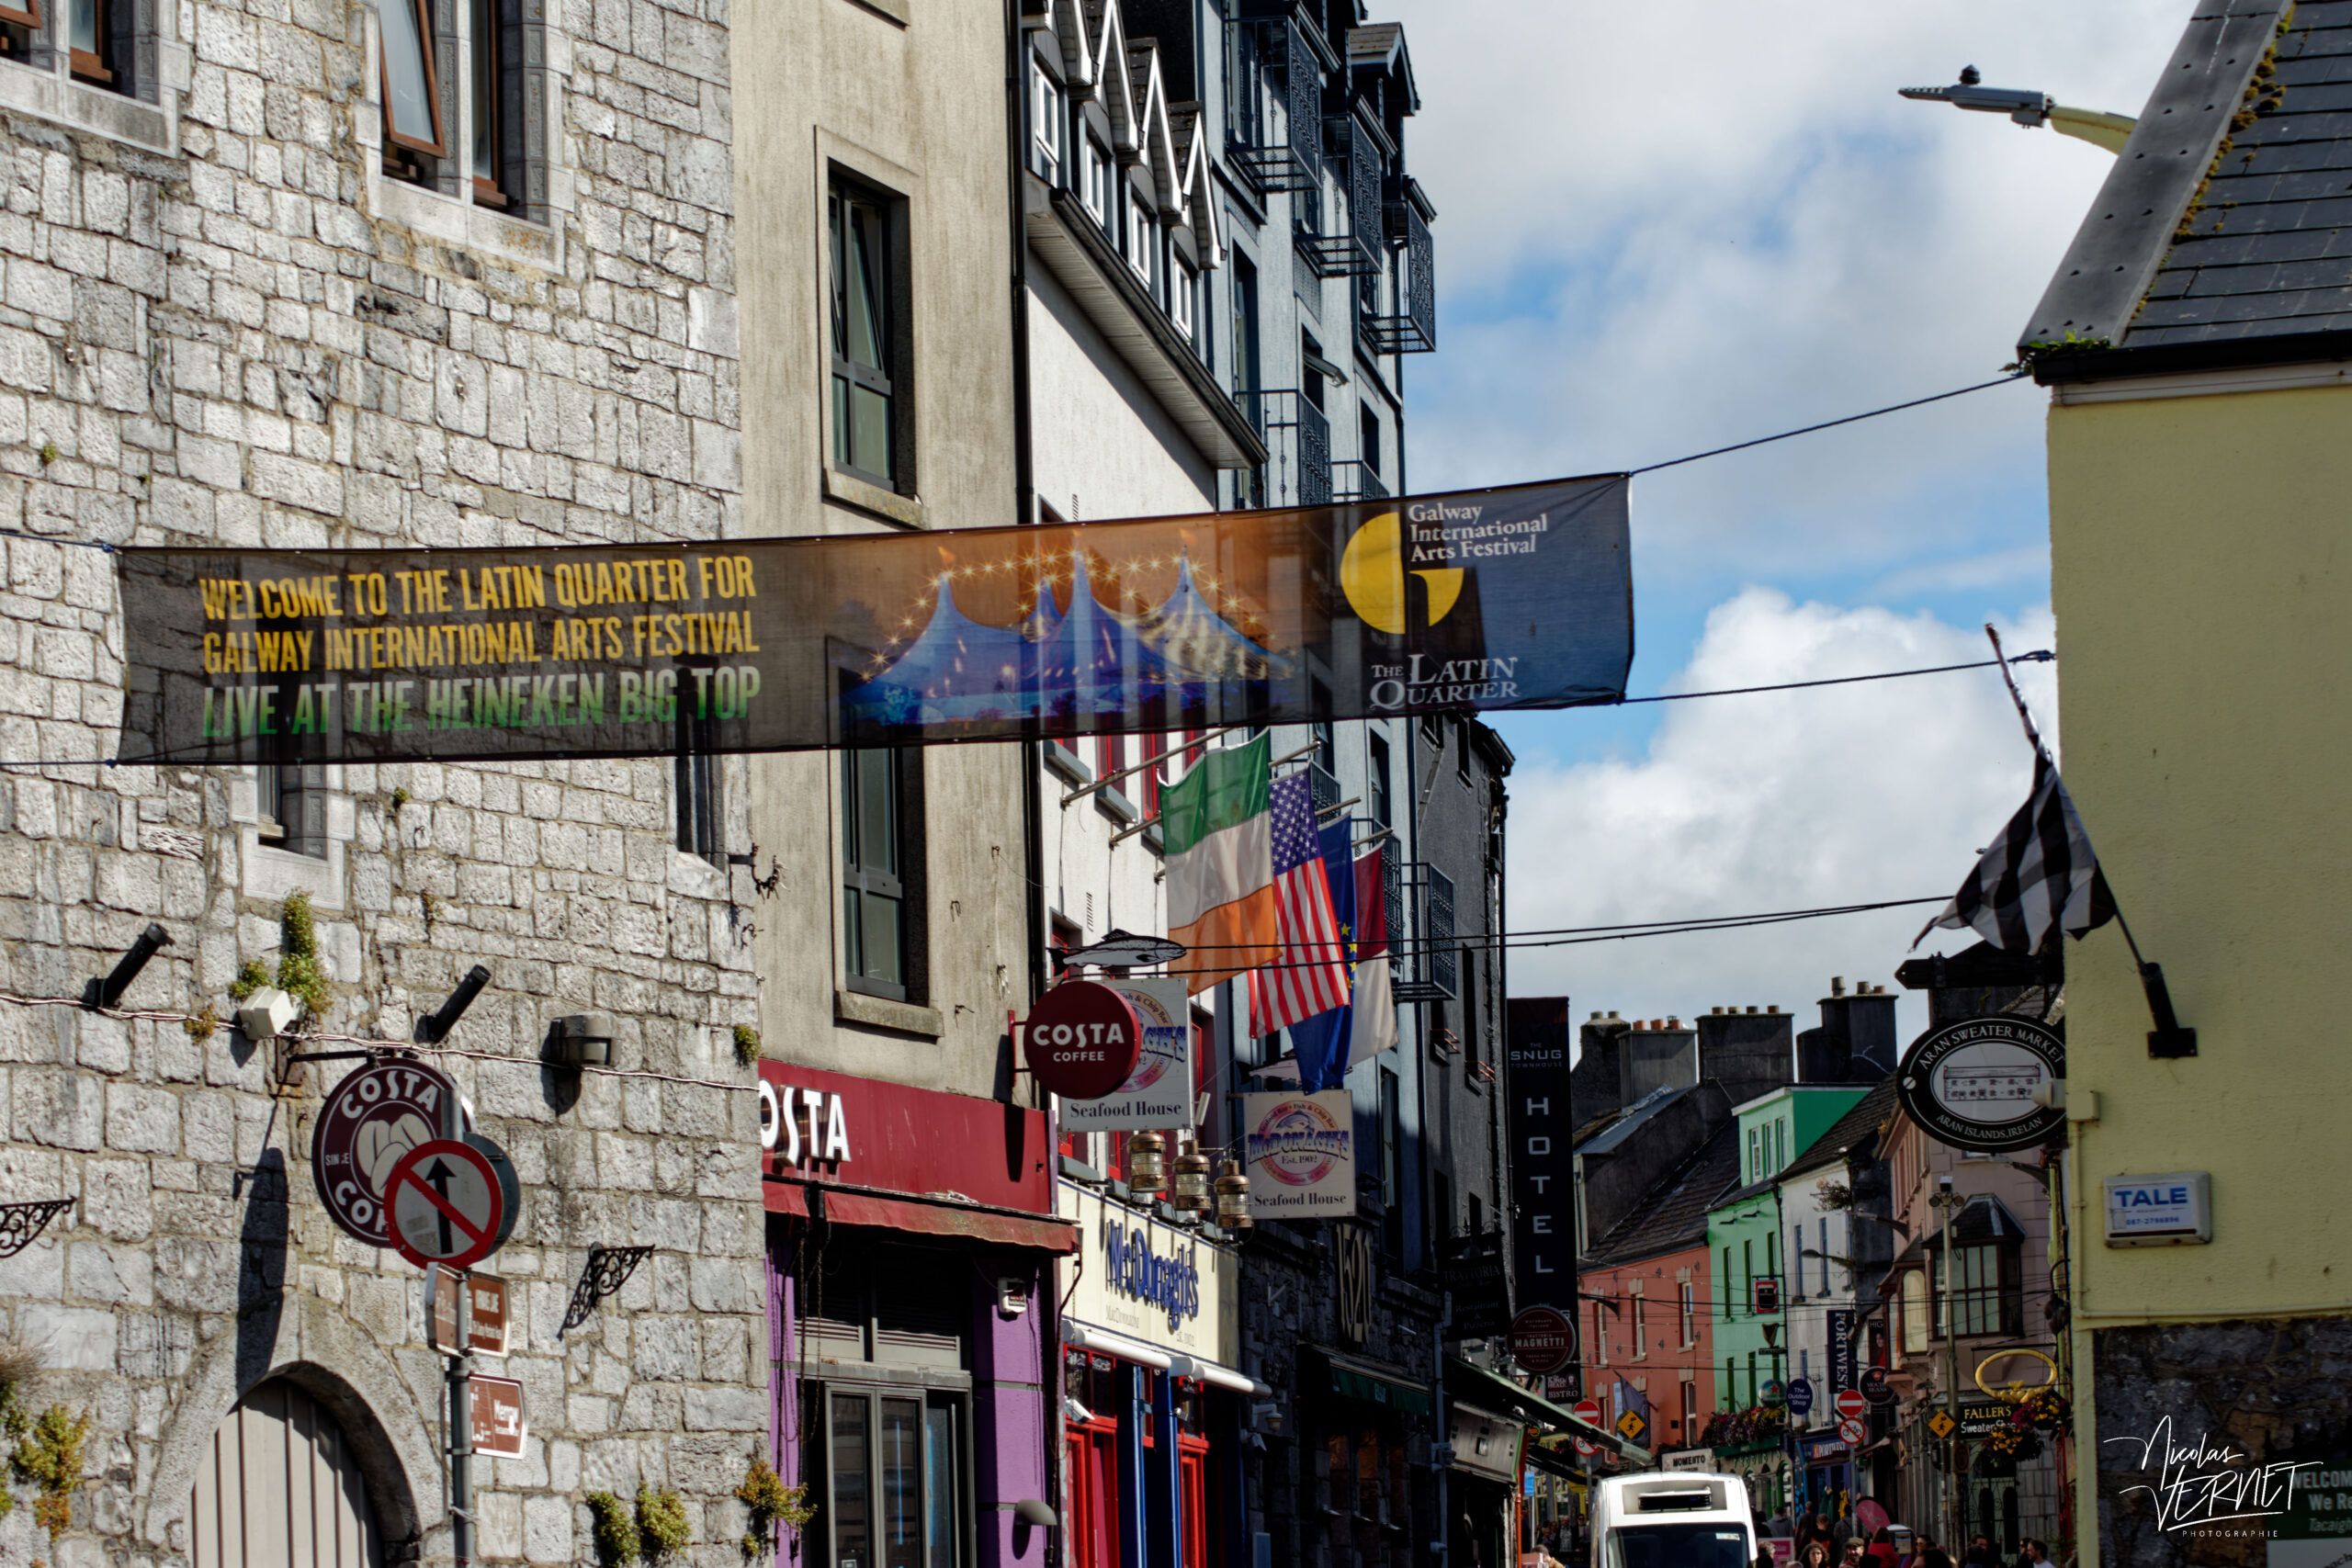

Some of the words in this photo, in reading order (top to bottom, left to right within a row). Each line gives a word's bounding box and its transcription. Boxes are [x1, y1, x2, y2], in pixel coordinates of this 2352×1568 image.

[1408, 502, 1483, 525] Galway
[1409, 513, 1549, 543] International
[1409, 544, 1456, 562] Arts
[1461, 535, 1537, 558] Festival
[199, 571, 340, 621] WELCOME
[348, 572, 388, 615] TO
[394, 570, 453, 614] THE
[461, 564, 546, 612] LATIN
[555, 558, 690, 607] QUARTER
[697, 556, 757, 599] FOR
[203, 631, 313, 676] GALWAY
[325, 622, 542, 671] INTERNATIONAL
[551, 616, 624, 662] ARTS
[633, 610, 761, 657] FESTIVAL
[1371, 663, 1404, 679] THE
[1408, 654, 1519, 685] LATIN
[203, 685, 277, 738] LIVE
[290, 682, 338, 735] AT
[348, 680, 413, 732] THE
[427, 671, 604, 730] HEINEKEN
[618, 667, 680, 724] BIG
[697, 664, 762, 721] TOP
[1369, 680, 1521, 711] QUARTER
[1143, 998, 1159, 1013] Chip
[1159, 1010, 1170, 1025] Bar
[1033, 1022, 1125, 1049] COSTA
[1053, 1051, 1105, 1063] COFFEE
[1510, 1049, 1563, 1061] SNUG
[1918, 1037, 1951, 1070] ARAN
[1952, 1025, 2013, 1045] SWEATER
[2017, 1028, 2066, 1063] MARKET
[341, 1070, 439, 1120] COSTA
[1069, 1100, 1133, 1118] Seafood
[1136, 1100, 1182, 1117] House
[1314, 1107, 1328, 1120] Chip
[1327, 1118, 1336, 1128] Bar
[759, 1077, 852, 1167] OSTA
[1936, 1114, 1967, 1134] ARAN
[2008, 1116, 2043, 1137] IRELAN
[1299, 1155, 1317, 1164] 1902
[1526, 1098, 1554, 1274] HOTEL
[2114, 1187, 2188, 1207] TALE
[1254, 1193, 1305, 1207] Seafood
[1308, 1192, 1347, 1205] House
[1110, 1219, 1199, 1331] McDonagh's
[1336, 1223, 1372, 1345] 1520
[1442, 1264, 1500, 1281] TRATTORIA
[1514, 1337, 1565, 1348] MAGNETTI
[1835, 1312, 1849, 1393] PORTWEST
[1548, 1389, 1578, 1398] BISTRO
[1788, 1393, 1811, 1401] Outdoor
[1961, 1421, 1996, 1434] Sweater
[1673, 1455, 1706, 1467] MOMENTO
[2288, 1470, 2352, 1490] WELCOM
[2308, 1493, 2333, 1512] We
